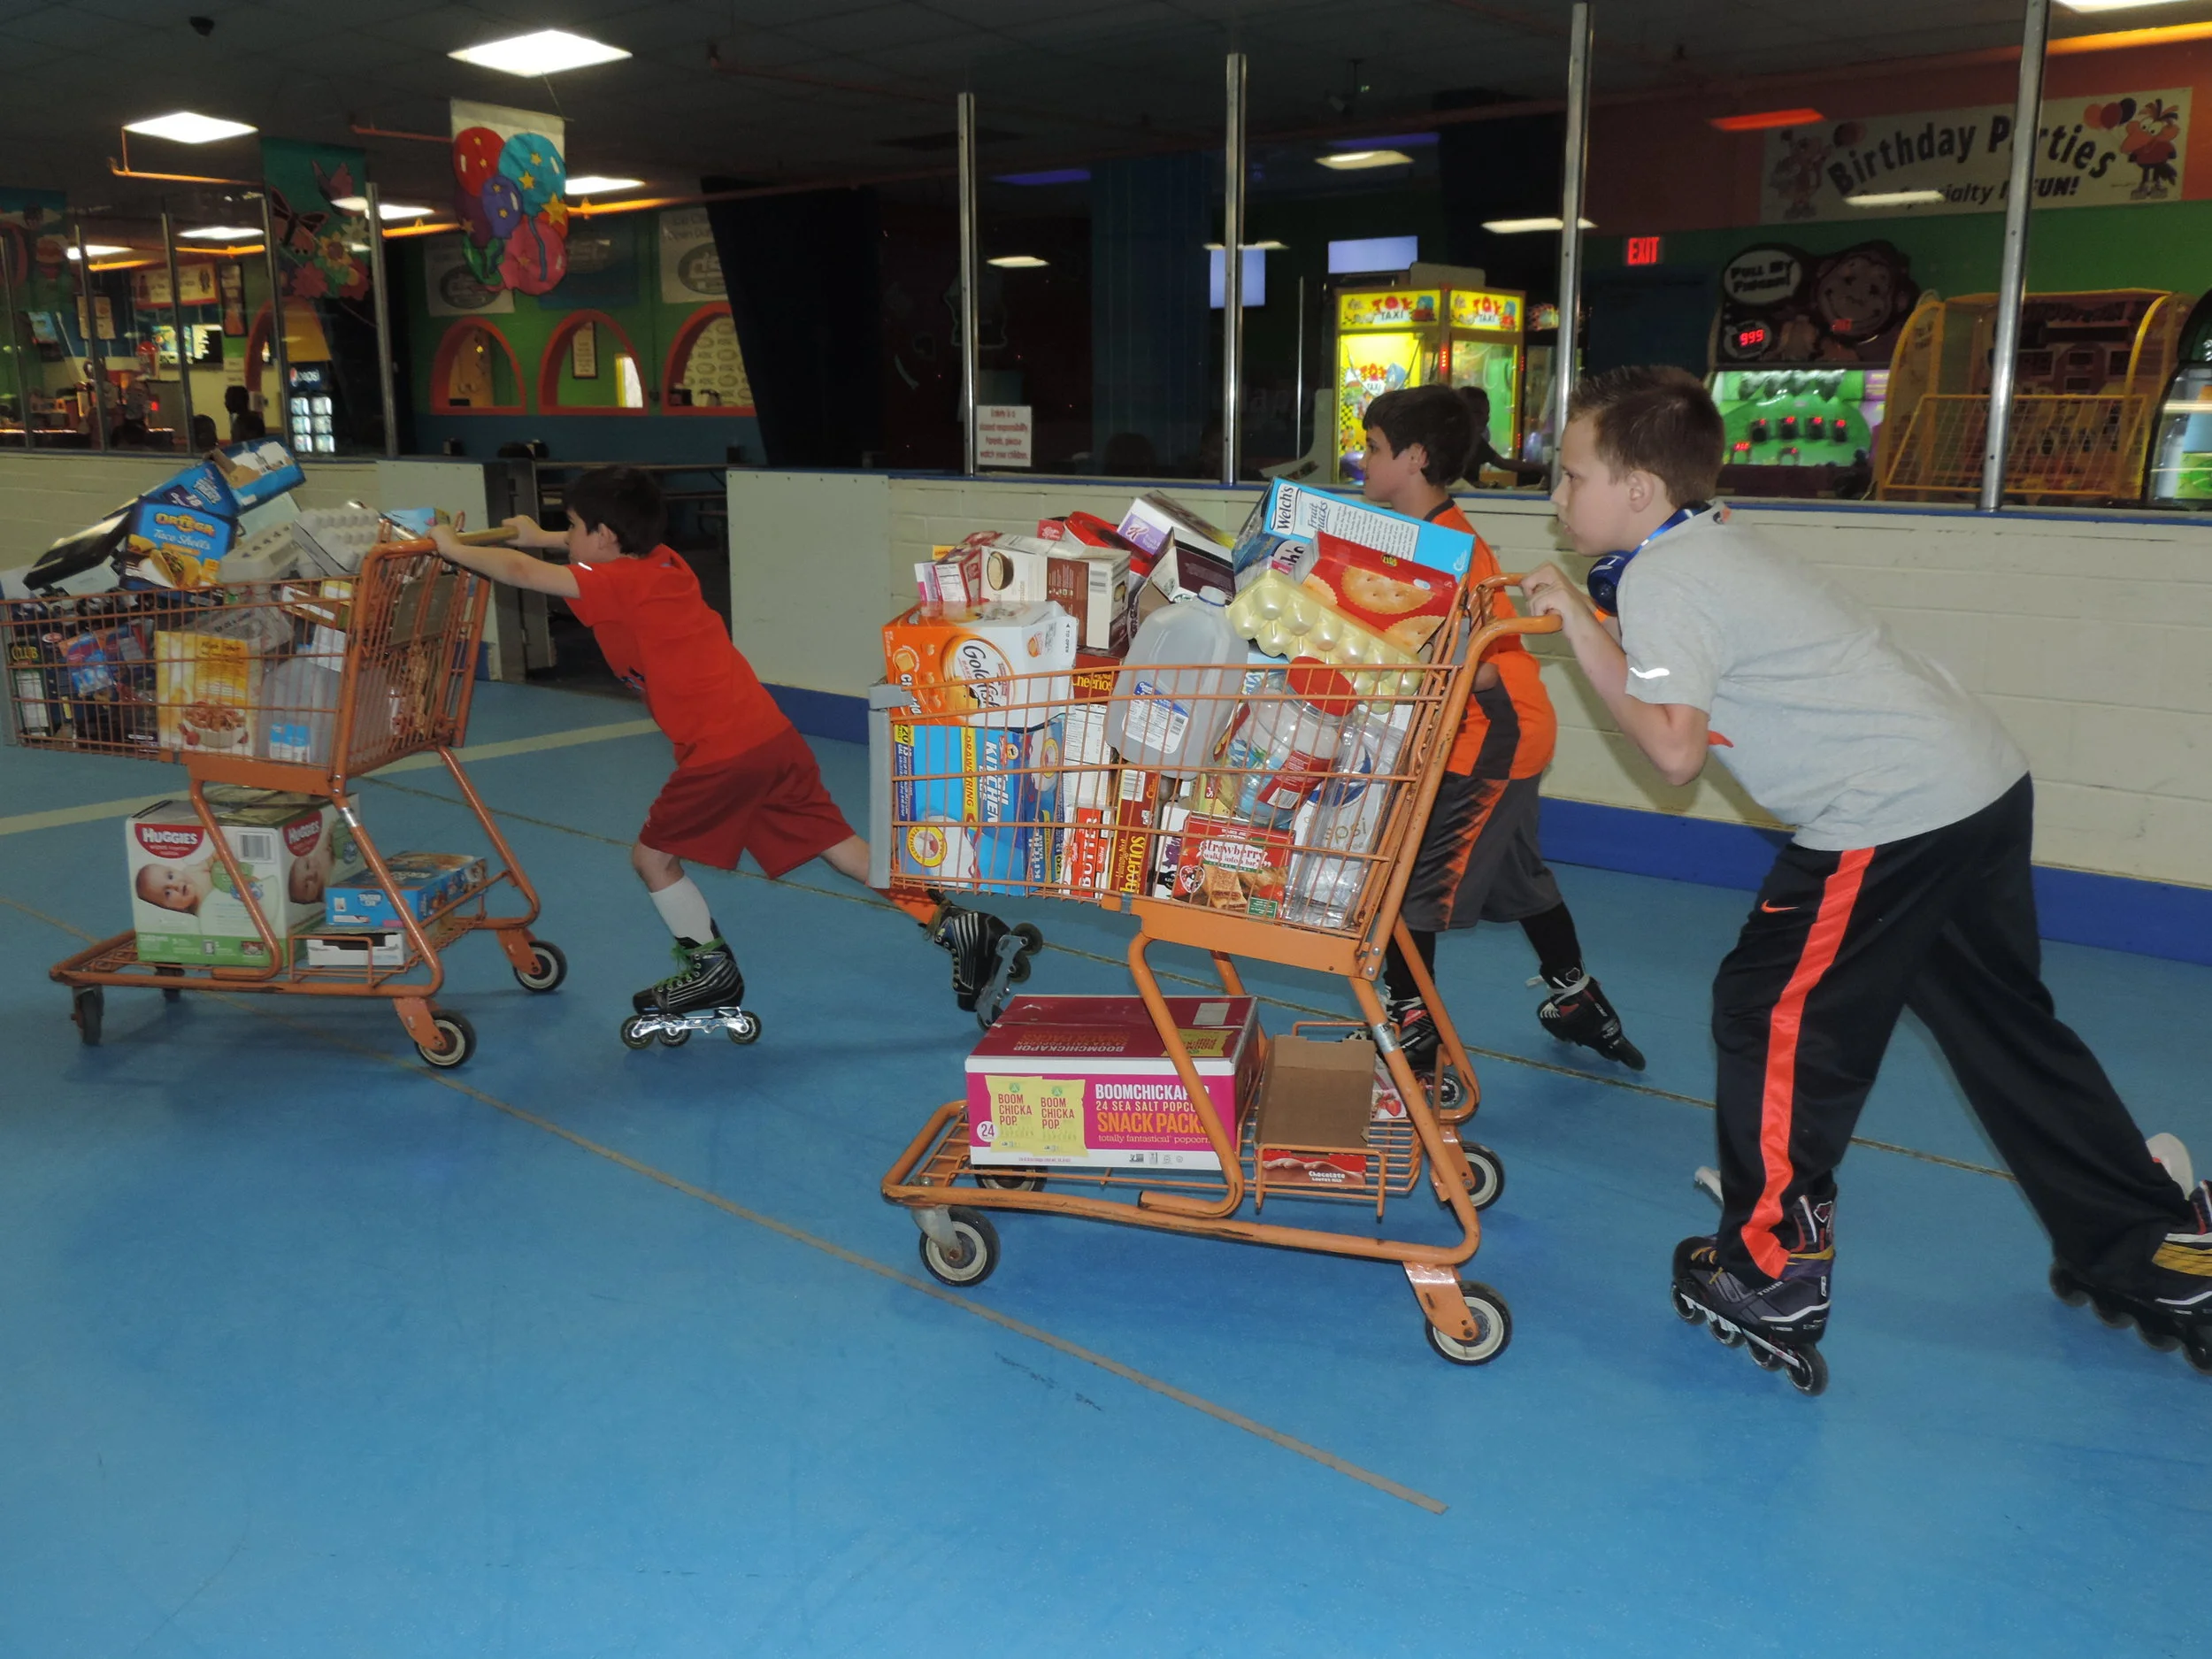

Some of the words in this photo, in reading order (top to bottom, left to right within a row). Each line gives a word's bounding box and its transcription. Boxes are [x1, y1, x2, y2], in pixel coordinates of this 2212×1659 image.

[1827, 121, 1976, 196] Birthday
[1987, 115, 2116, 179] Prties
[1628, 236, 1660, 265] EXIT
[1372, 295, 1413, 311] TOY
[1472, 296, 1502, 315] TOY
[1381, 310, 1405, 320] TAXI
[1479, 313, 1495, 323] TAXI
[1277, 485, 1294, 531] Welch's
[1307, 503, 1319, 528] Fruit
[1318, 500, 1329, 532] nacks
[155, 512, 215, 538] ORTEGA
[142, 827, 198, 845] HUGGIES
[288, 820, 319, 844] HUGGIES
[1080, 817, 1097, 887] BUTTER
[1119, 835, 1146, 894] heerios
[998, 1094, 1024, 1104] BOOM
[1041, 1097, 1066, 1108] BOOM
[1095, 1101, 1108, 1111] 24
[1112, 1101, 1132, 1111] SEA
[1135, 1101, 1158, 1111] SALT
[999, 1104, 1033, 1115] CHICKA
[1041, 1108, 1075, 1118] CHICKA
[980, 1123, 995, 1137] 24
[1097, 1111, 1154, 1133] SNACK
[1098, 1134, 1124, 1143] totally
[1309, 1170, 1345, 1179] Chocolate
